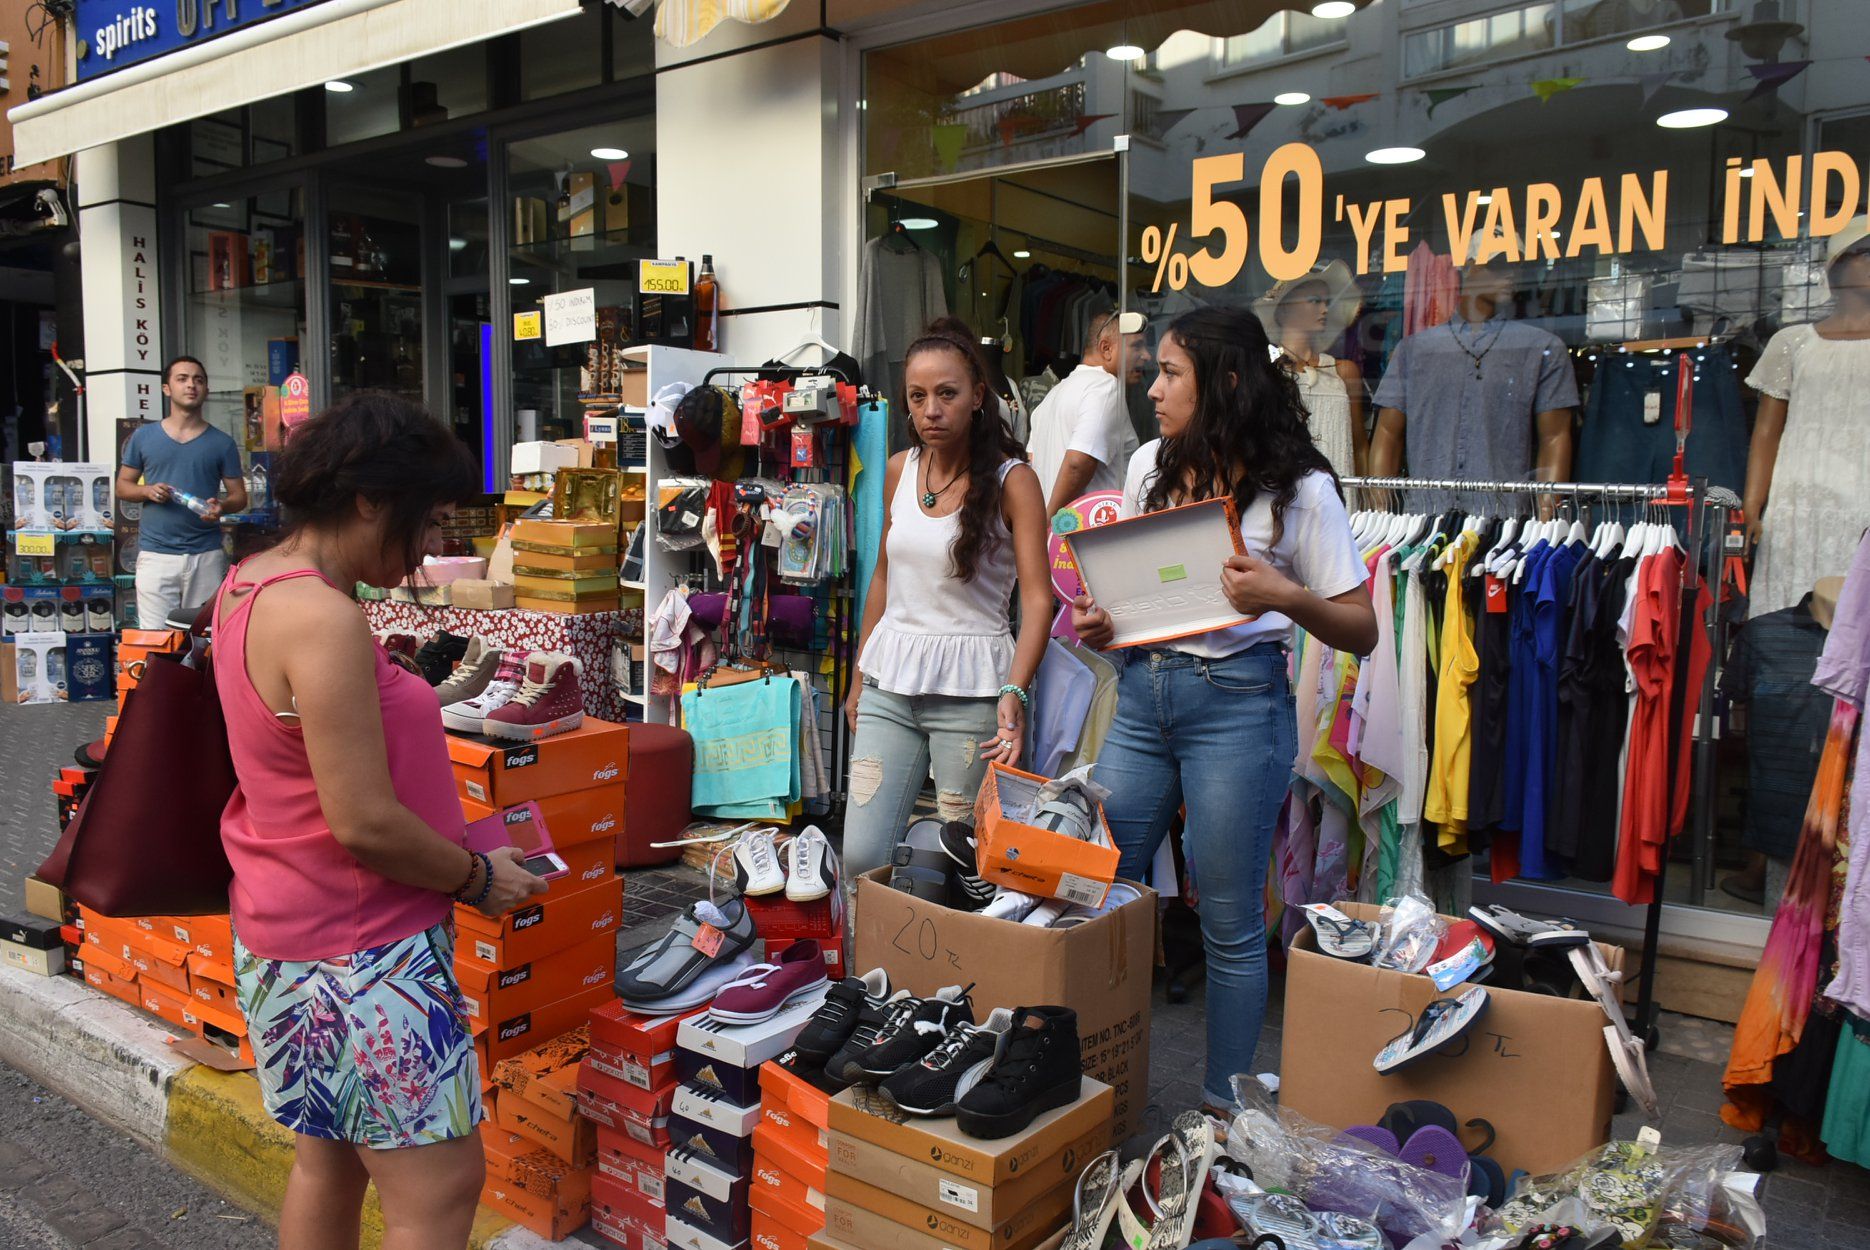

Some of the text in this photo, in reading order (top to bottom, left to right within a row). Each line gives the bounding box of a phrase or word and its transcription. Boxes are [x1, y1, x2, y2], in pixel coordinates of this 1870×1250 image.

[96, 6, 156, 60] spirits
[1442, 169, 1668, 267] VARAN
[1722, 150, 1870, 244] İND
[133, 236, 146, 310] HALİS
[136, 318, 149, 361] KÖY
[507, 754, 535, 767] fogs
[593, 768, 619, 780] fogs
[591, 819, 616, 833] fogs
[581, 866, 606, 881] fogs
[515, 912, 541, 929] fogs
[591, 914, 615, 930] fogs
[892, 906, 938, 961] 20
[196, 945, 213, 957] fogs
[501, 970, 527, 987] fogs
[582, 969, 607, 986] fogs
[195, 988, 212, 1000] fogs
[145, 998, 160, 1011] fogs
[501, 1022, 528, 1041] fogs
[1107, 1059, 1129, 1082] BLACK
[1115, 1080, 1129, 1099] PCS
[765, 1109, 792, 1127] fogs
[526, 1121, 558, 1142] cheta
[837, 1147, 857, 1162] FOR
[943, 1151, 975, 1171] ganzi
[757, 1168, 782, 1187] fogs
[505, 1197, 535, 1218] cheta
[834, 1213, 853, 1228] FOR
[756, 1233, 781, 1250] fogs
